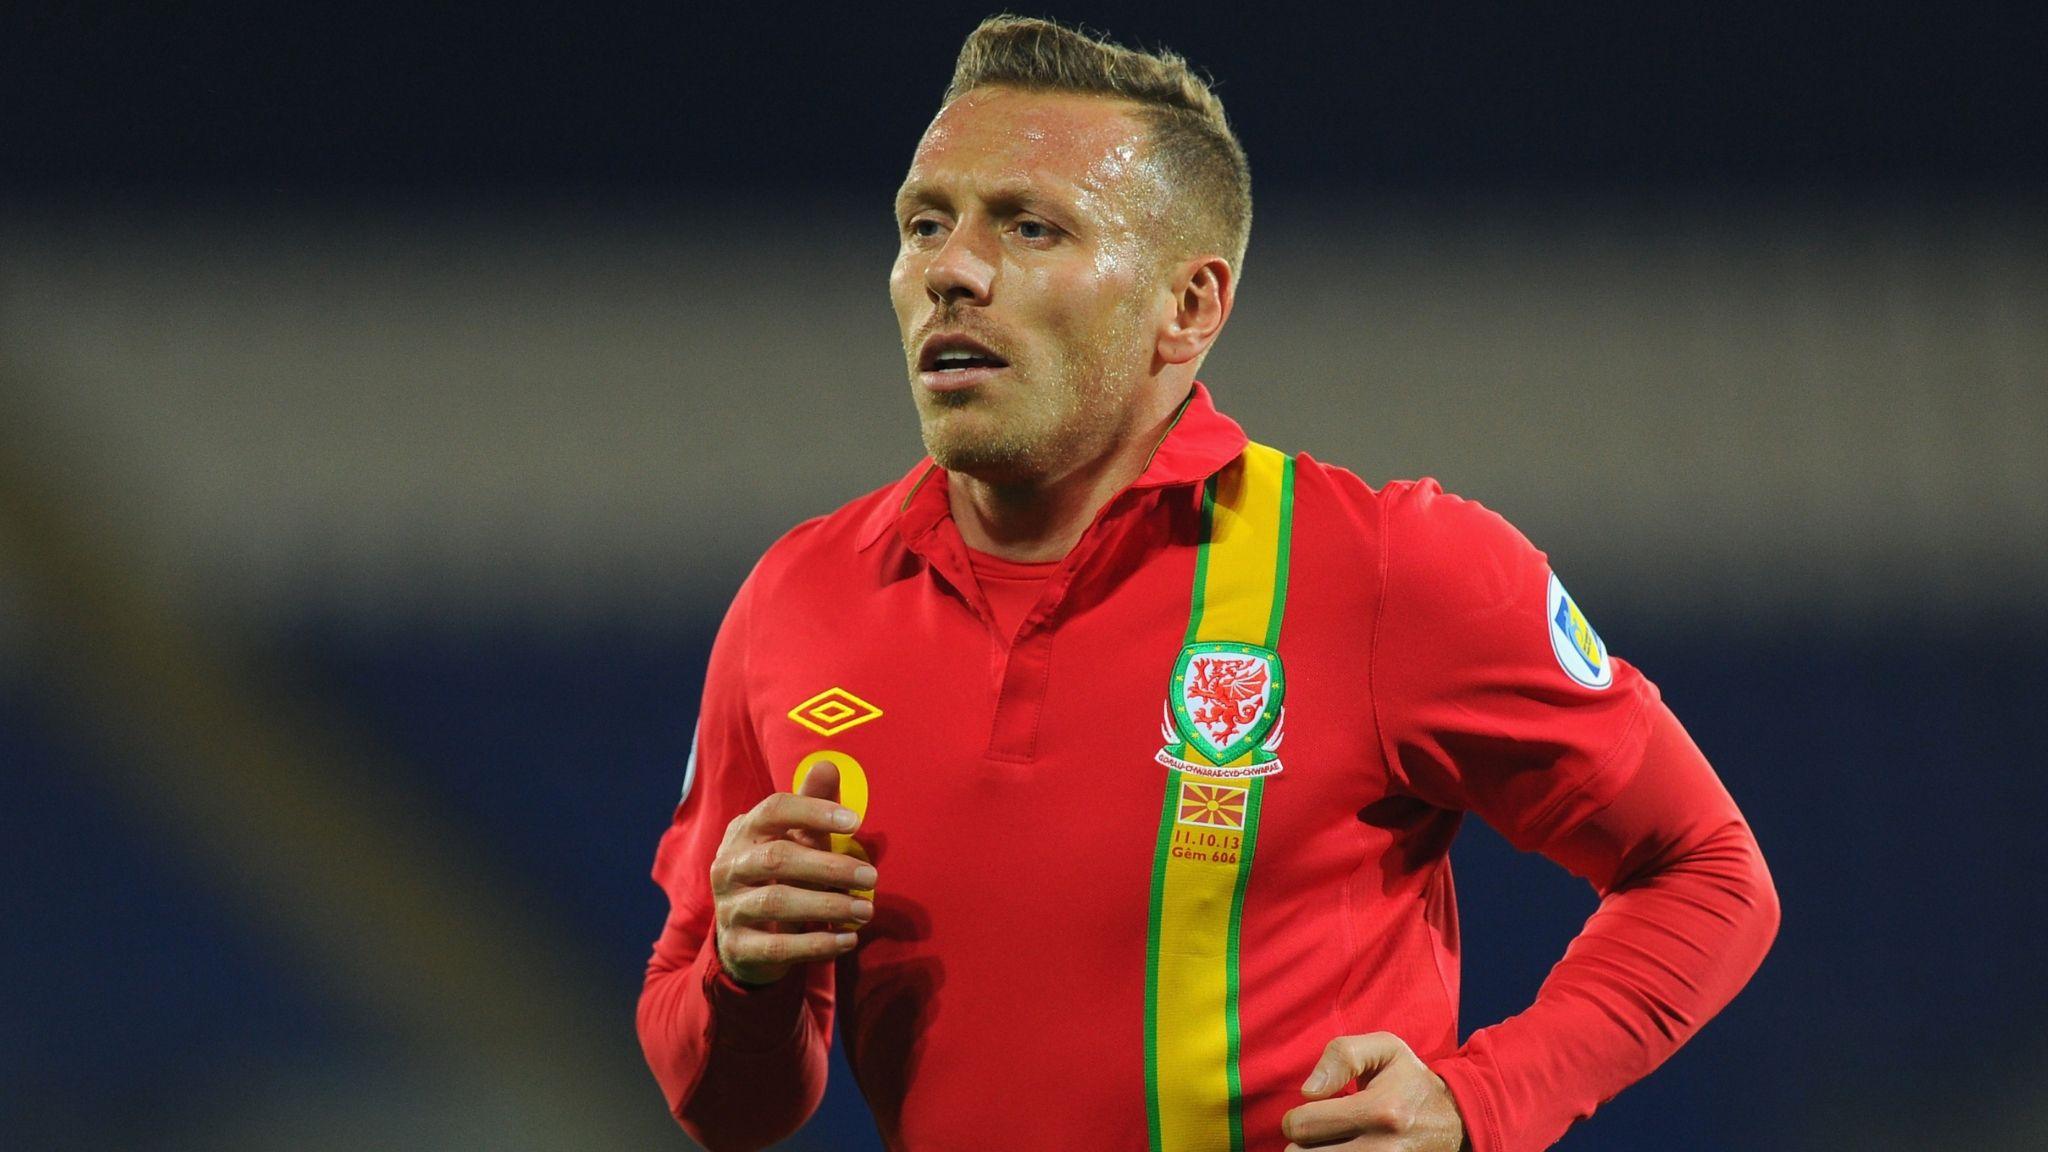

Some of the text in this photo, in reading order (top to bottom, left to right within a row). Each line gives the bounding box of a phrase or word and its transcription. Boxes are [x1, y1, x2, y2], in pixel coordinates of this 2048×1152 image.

[1175, 830, 1240, 850] 11.10.13
[1172, 846, 1236, 865] Gêm 606
